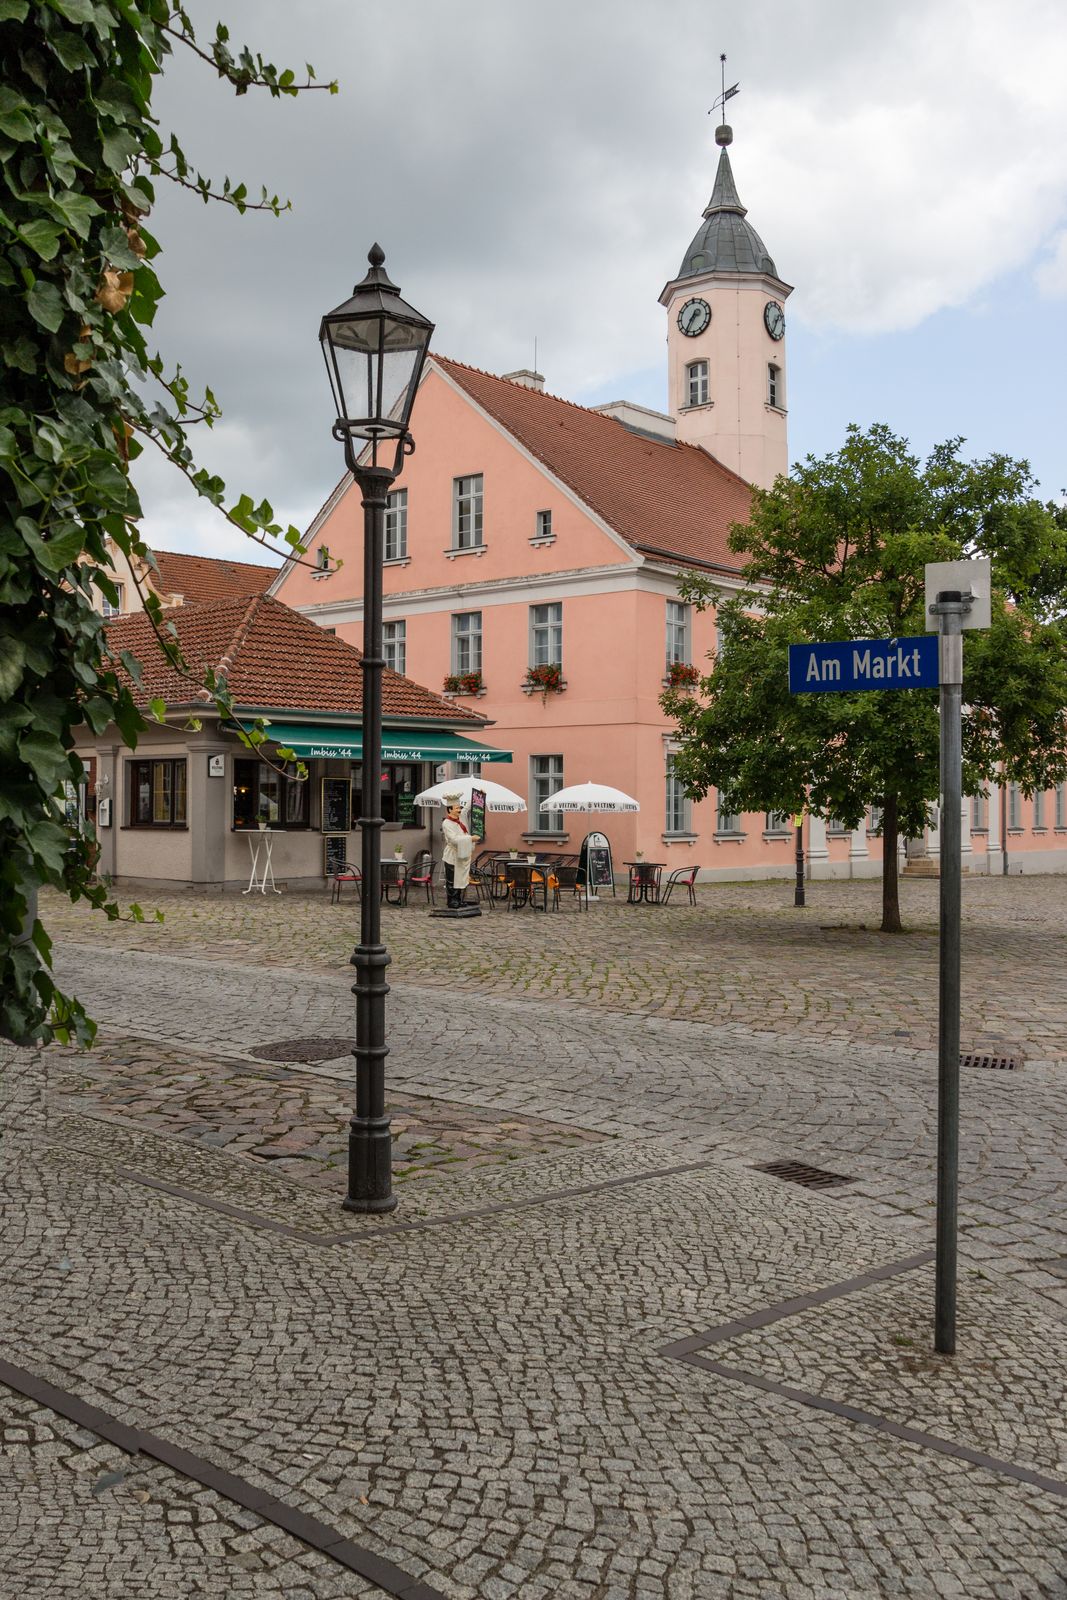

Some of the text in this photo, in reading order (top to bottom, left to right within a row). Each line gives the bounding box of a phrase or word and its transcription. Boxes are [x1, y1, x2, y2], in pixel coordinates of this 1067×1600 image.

[806, 648, 921, 682] Am Markt
[310, 747, 337, 757] Imbiss
[383, 748, 407, 759] Imbiss
[456, 752, 478, 761] Imbiss
